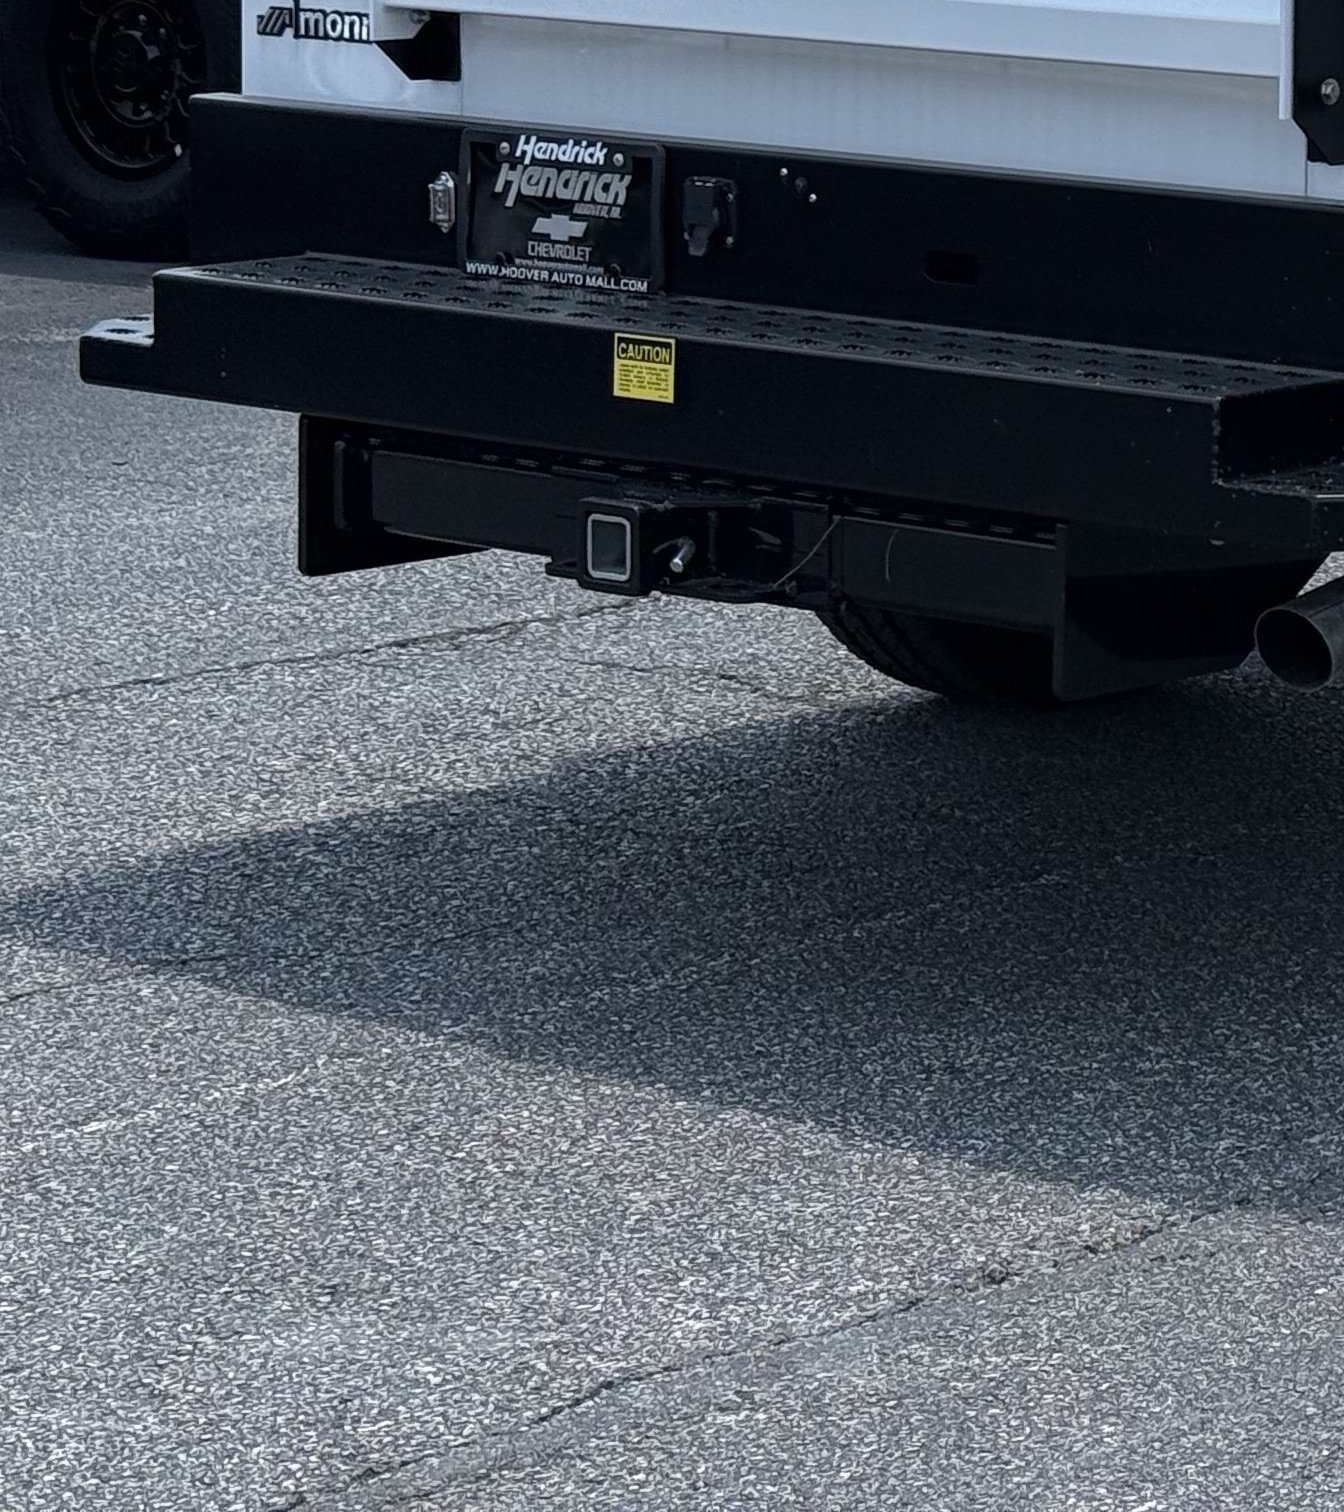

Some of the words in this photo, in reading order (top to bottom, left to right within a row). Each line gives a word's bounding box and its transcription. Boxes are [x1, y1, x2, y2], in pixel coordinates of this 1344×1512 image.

[515, 135, 608, 165] Hendrick
[528, 240, 592, 263] CHEVROLET
[551, 272, 583, 285] AUTO
[618, 342, 671, 364] CAUTION
